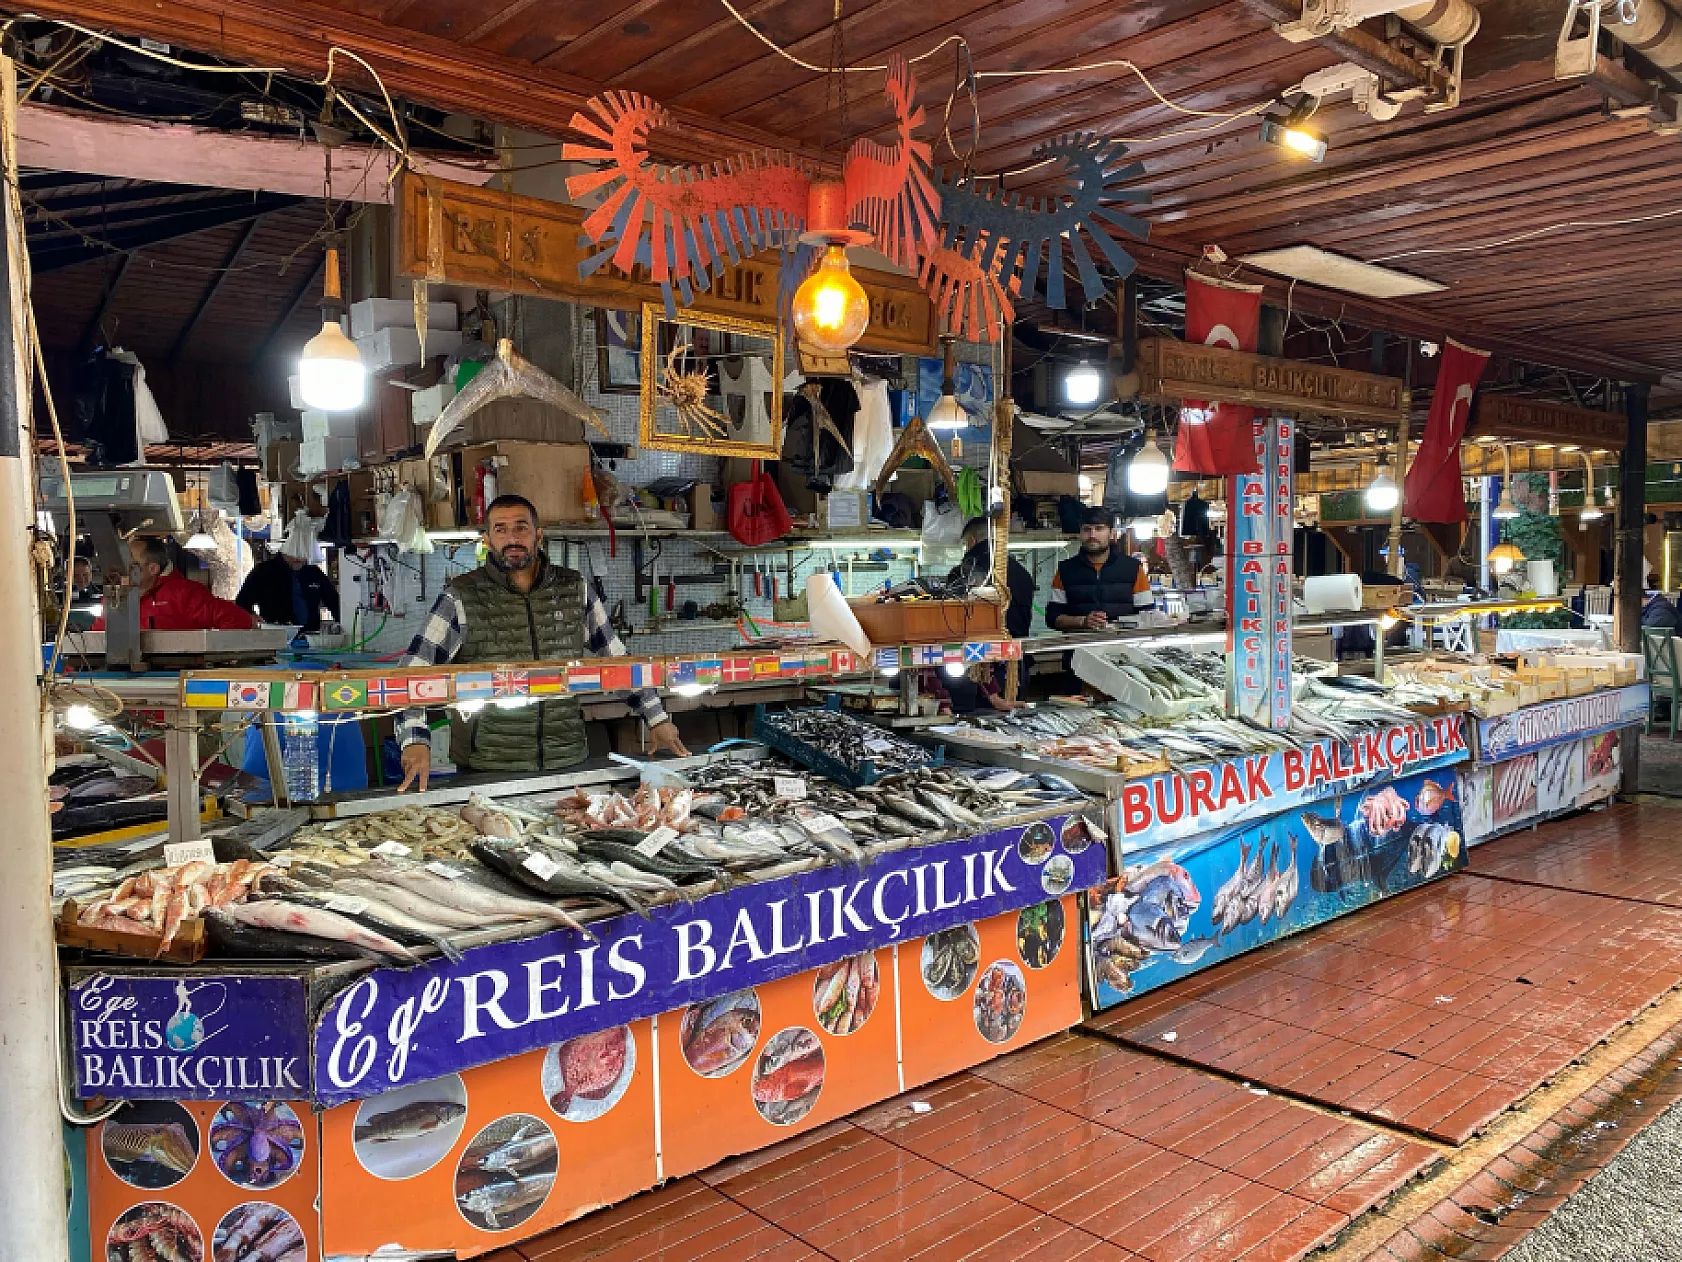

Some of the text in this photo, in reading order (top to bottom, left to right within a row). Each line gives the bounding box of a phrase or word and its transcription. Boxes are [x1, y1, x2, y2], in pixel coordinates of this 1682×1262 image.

[1278, 424, 1290, 517] BURAK
[1240, 541, 1264, 708] BALIKÇILI
[1122, 715, 1467, 836] BURAK BALIKÇILIK
[80, 975, 139, 1023] Ege
[327, 844, 1017, 1089] Ege REİS BALIKÇILIK
[81, 1012, 163, 1050] REİS
[82, 1053, 303, 1097] BALIKÇILIK
